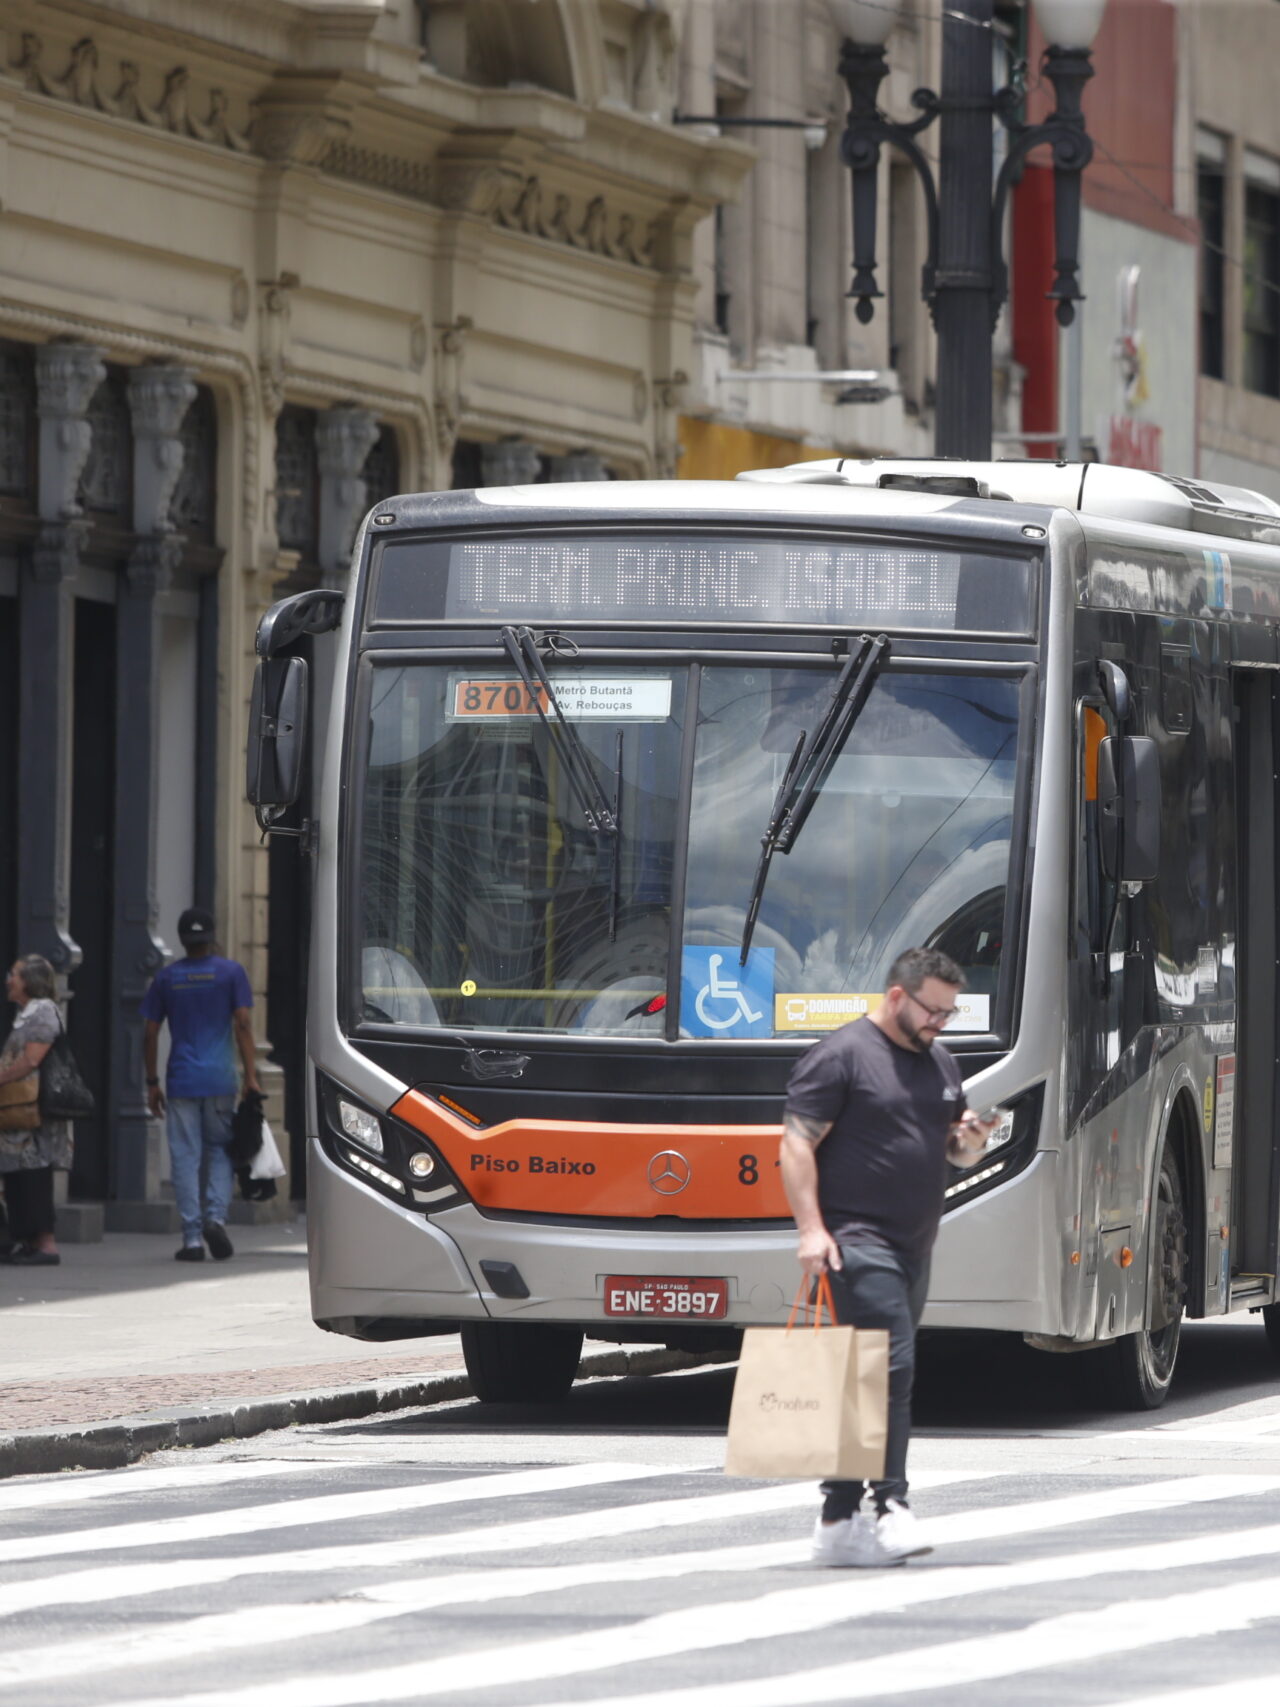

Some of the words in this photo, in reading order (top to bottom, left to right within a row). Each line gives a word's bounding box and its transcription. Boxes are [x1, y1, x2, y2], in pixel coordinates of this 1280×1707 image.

[464, 545, 600, 603] TERM.
[617, 548, 769, 607] PRINC.
[785, 551, 957, 611] ISABEL
[555, 685, 587, 695] Metrô
[590, 685, 633, 695] Butantã
[579, 700, 633, 711] Rebouças
[808, 996, 868, 1013] DOMINGÃO
[470, 1154, 520, 1172] Piso
[529, 1156, 597, 1175] Baixo
